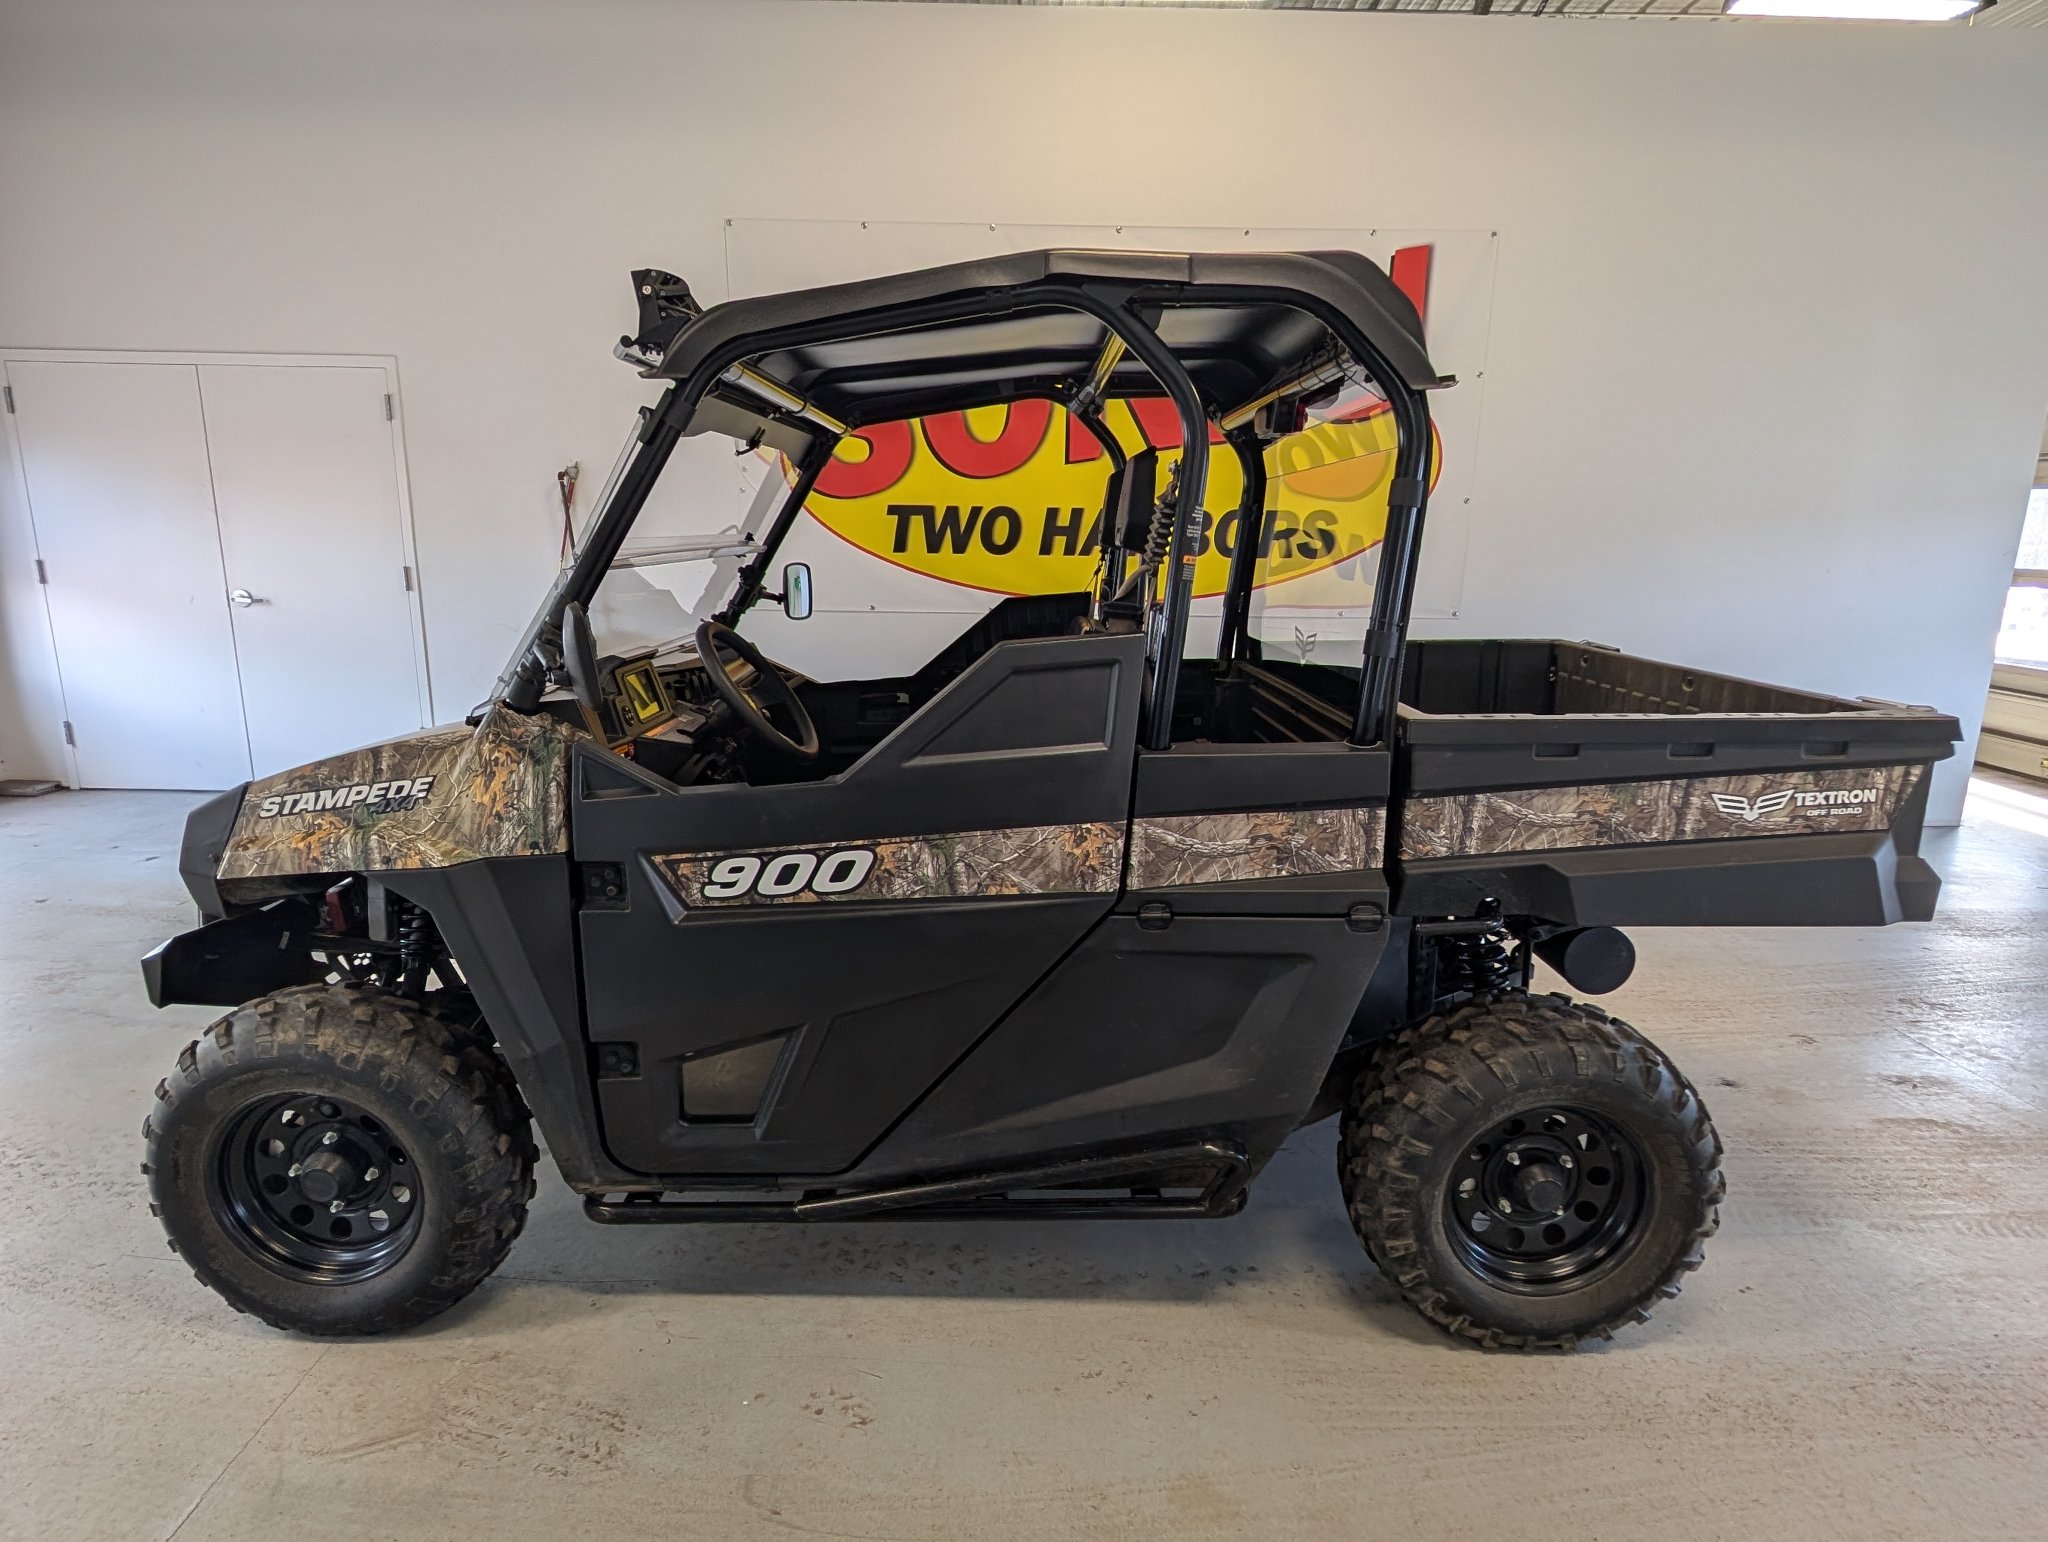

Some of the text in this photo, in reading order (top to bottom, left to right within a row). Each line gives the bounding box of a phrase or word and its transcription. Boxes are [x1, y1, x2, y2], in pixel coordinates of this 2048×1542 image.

[886, 504, 1022, 556] TWO
[258, 775, 436, 818] STAMPEDE
[1794, 789, 1877, 806] TEXTRON
[1830, 807, 1863, 815] ROAD
[702, 849, 875, 898] 900
